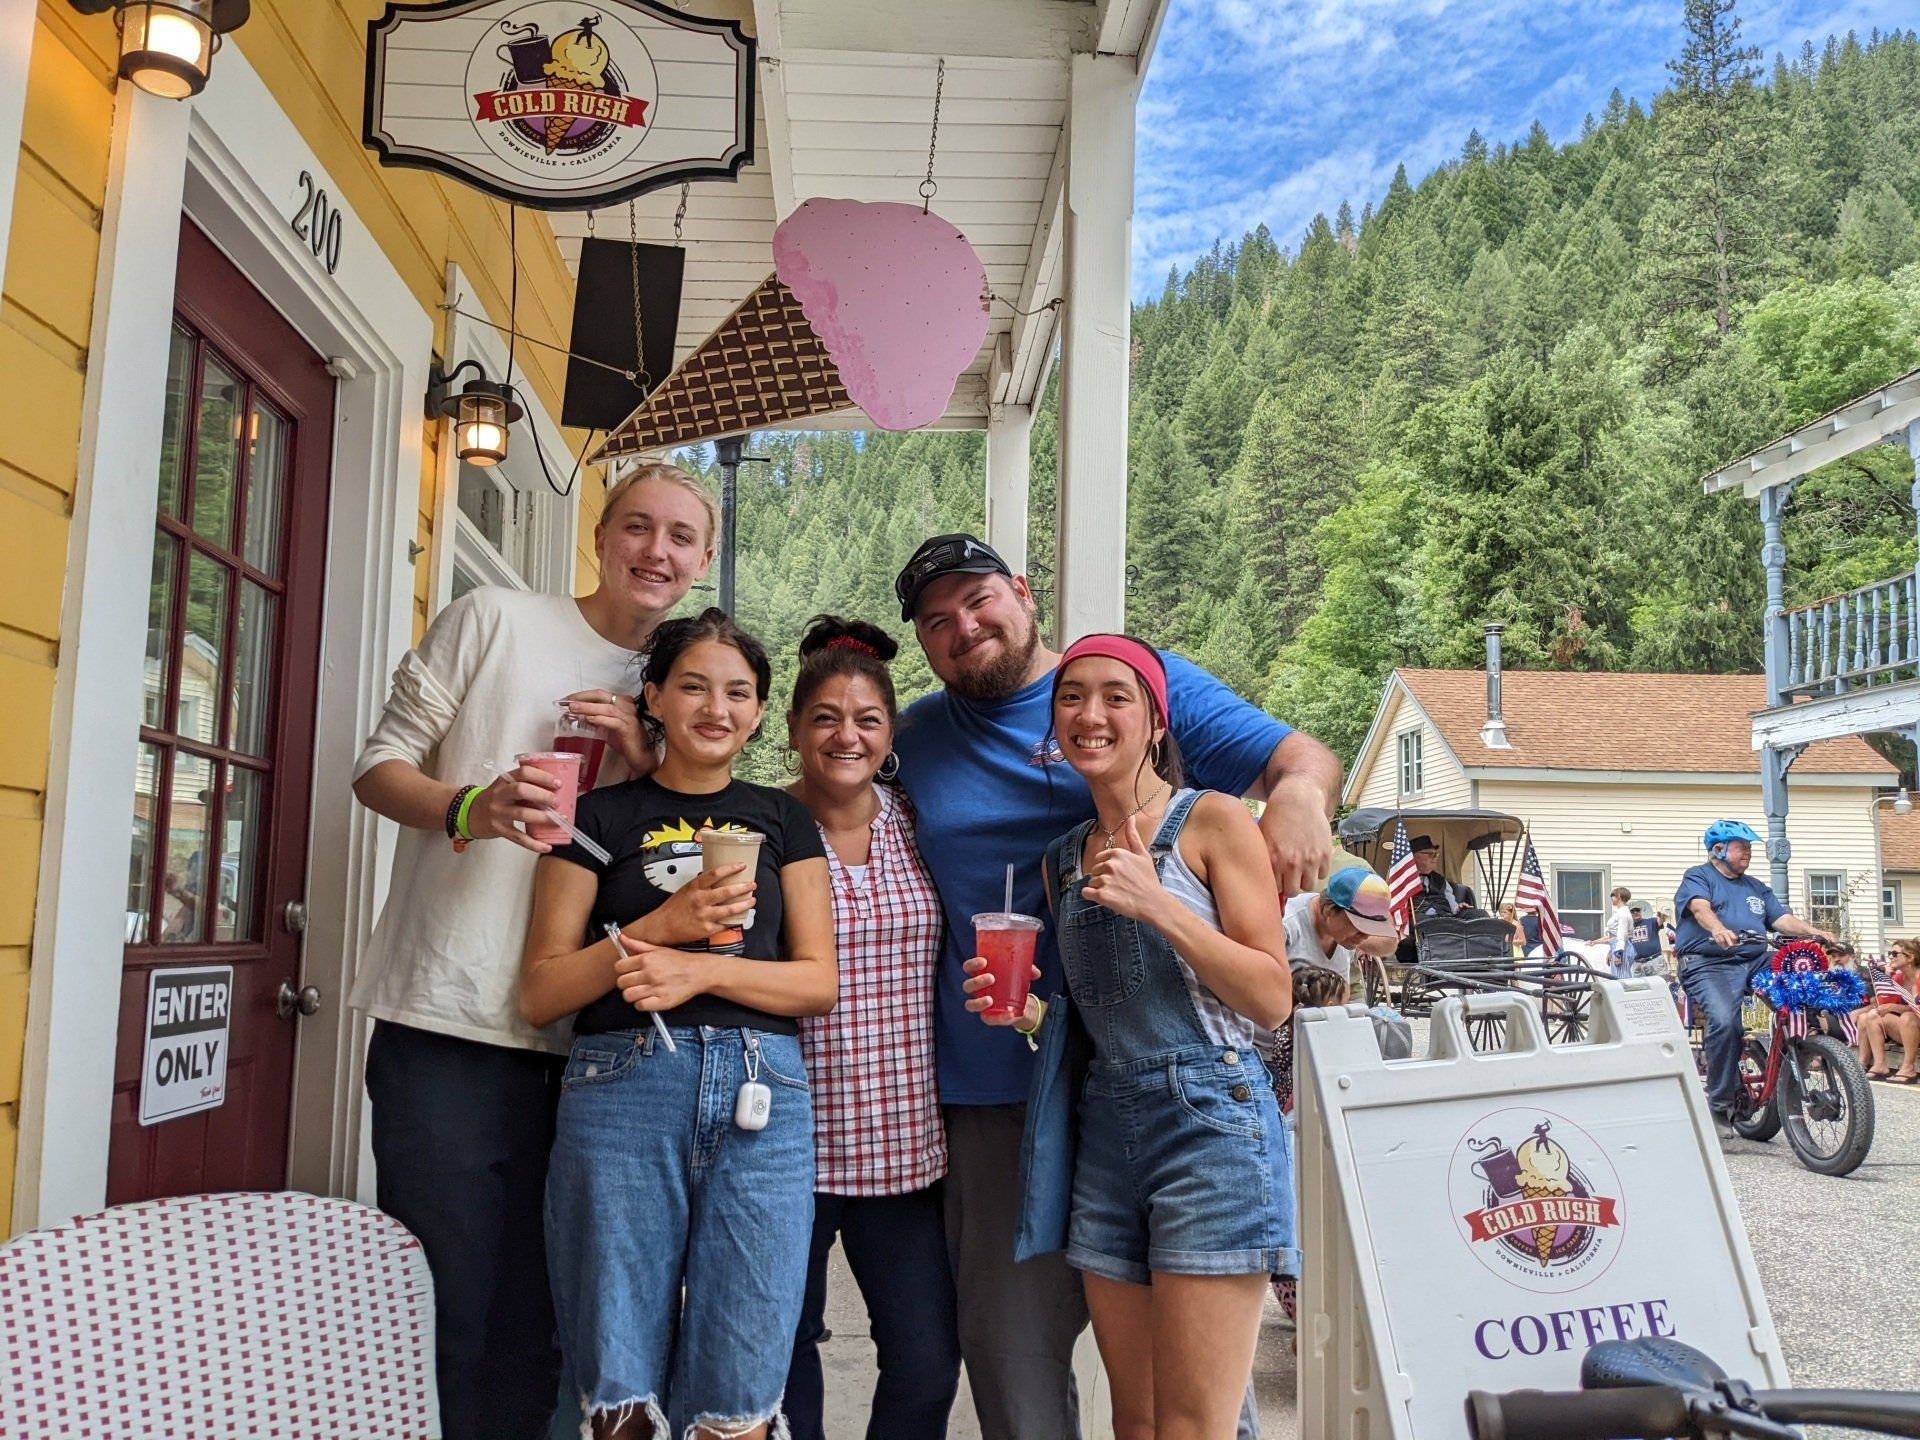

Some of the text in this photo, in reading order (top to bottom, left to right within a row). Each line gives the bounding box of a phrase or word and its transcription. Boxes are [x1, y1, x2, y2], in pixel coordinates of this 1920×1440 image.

[494, 92, 630, 122] COLD RUSH
[499, 131, 622, 166] DOWNIEVILLE CALIFORNIA
[518, 122, 541, 140] COFFEE
[291, 170, 342, 275] 200
[153, 983, 228, 1026] ENTER
[155, 1040, 219, 1087] ONLY
[1482, 1200, 1601, 1235] COLD RUSH
[1495, 1238, 1603, 1278] DOWNIEVILLE CALIFORNIA
[1474, 1299, 1676, 1360] COFFEE
